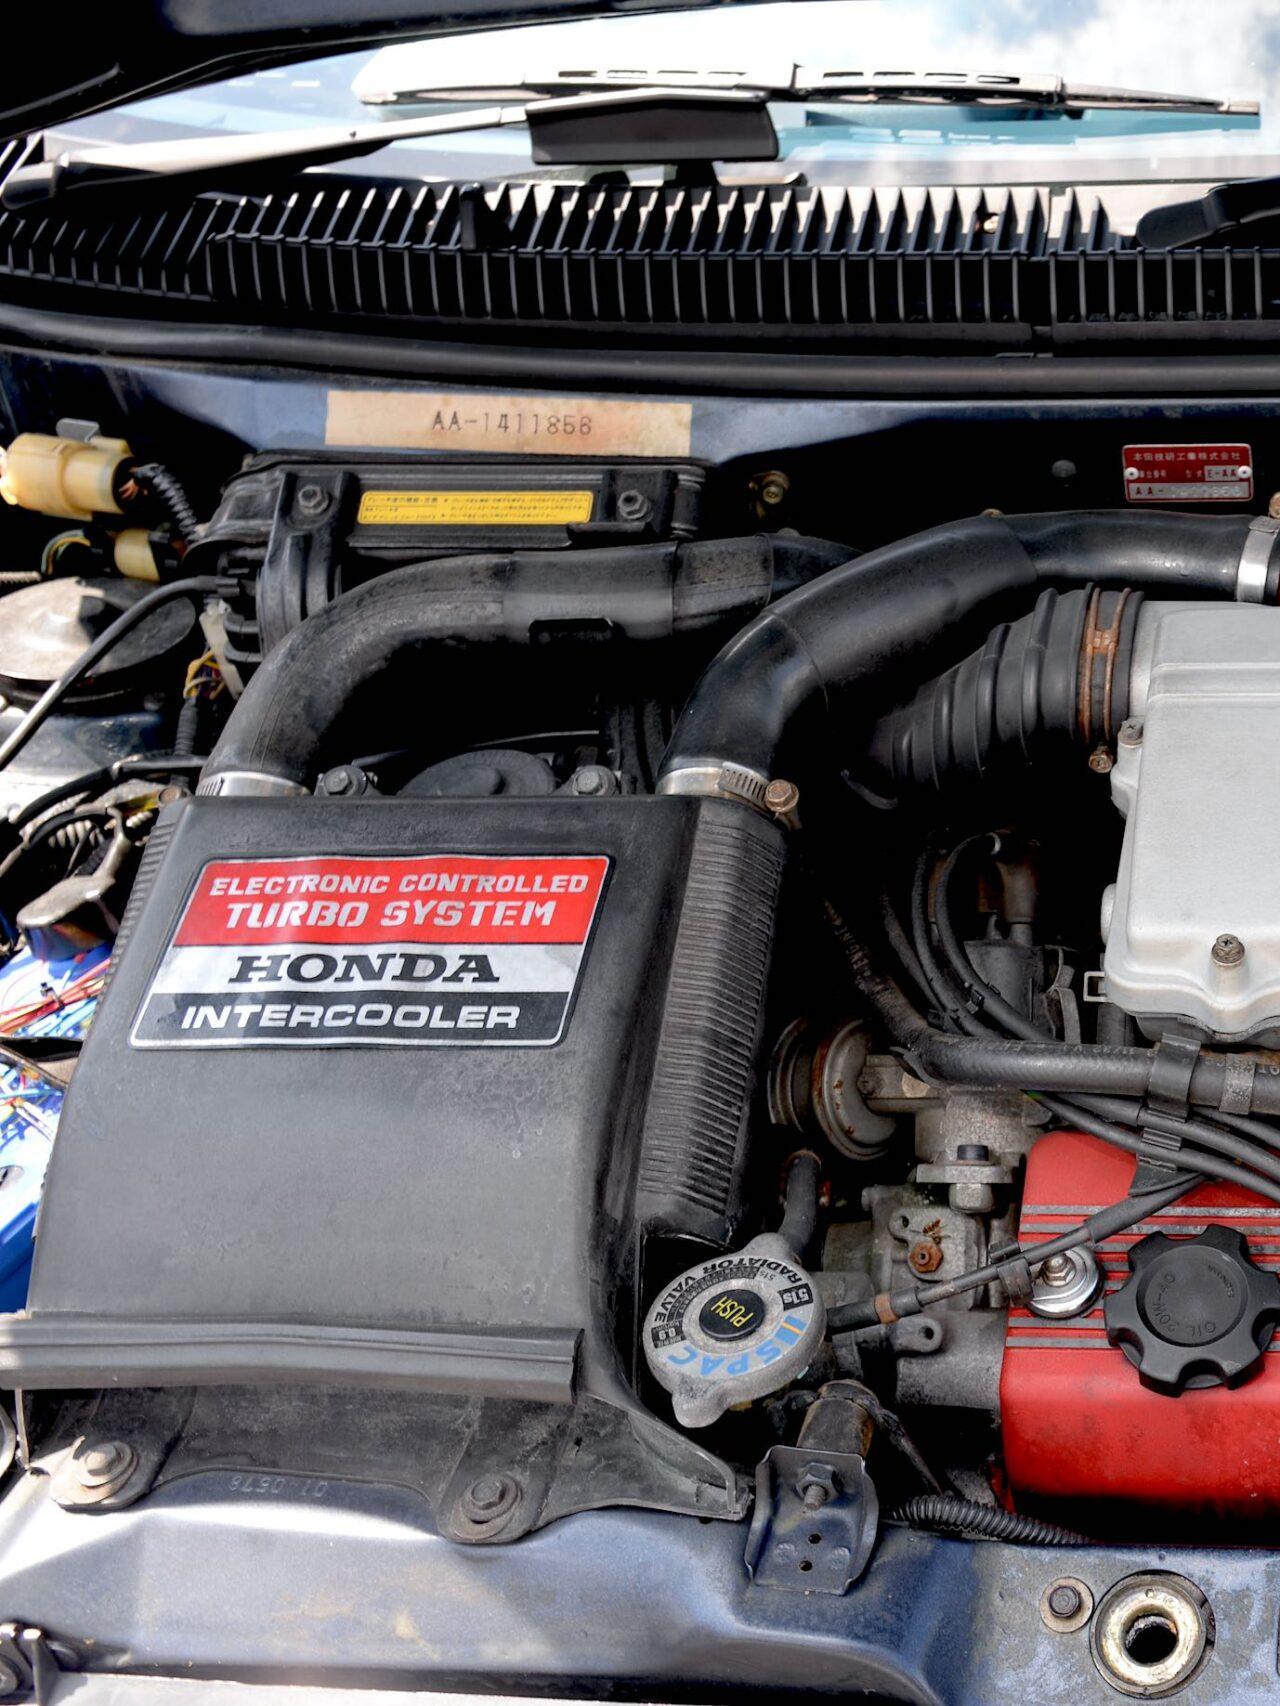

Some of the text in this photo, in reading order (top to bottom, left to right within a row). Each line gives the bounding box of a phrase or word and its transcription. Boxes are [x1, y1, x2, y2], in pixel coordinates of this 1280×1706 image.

[432, 410, 592, 436] AA-1411856
[1132, 451, 1241, 461] 本田技研工業株式会社
[209, 871, 589, 896] ELECTRONIC CONTROLLED
[225, 899, 557, 929] TURBO SYSTEM
[227, 953, 501, 984] HONDA
[180, 1004, 521, 1030] INTERCOOLER
[702, 1257, 803, 1284] RADIATOR
[654, 1275, 698, 1323] VALVE
[711, 1296, 755, 1328] PUSH
